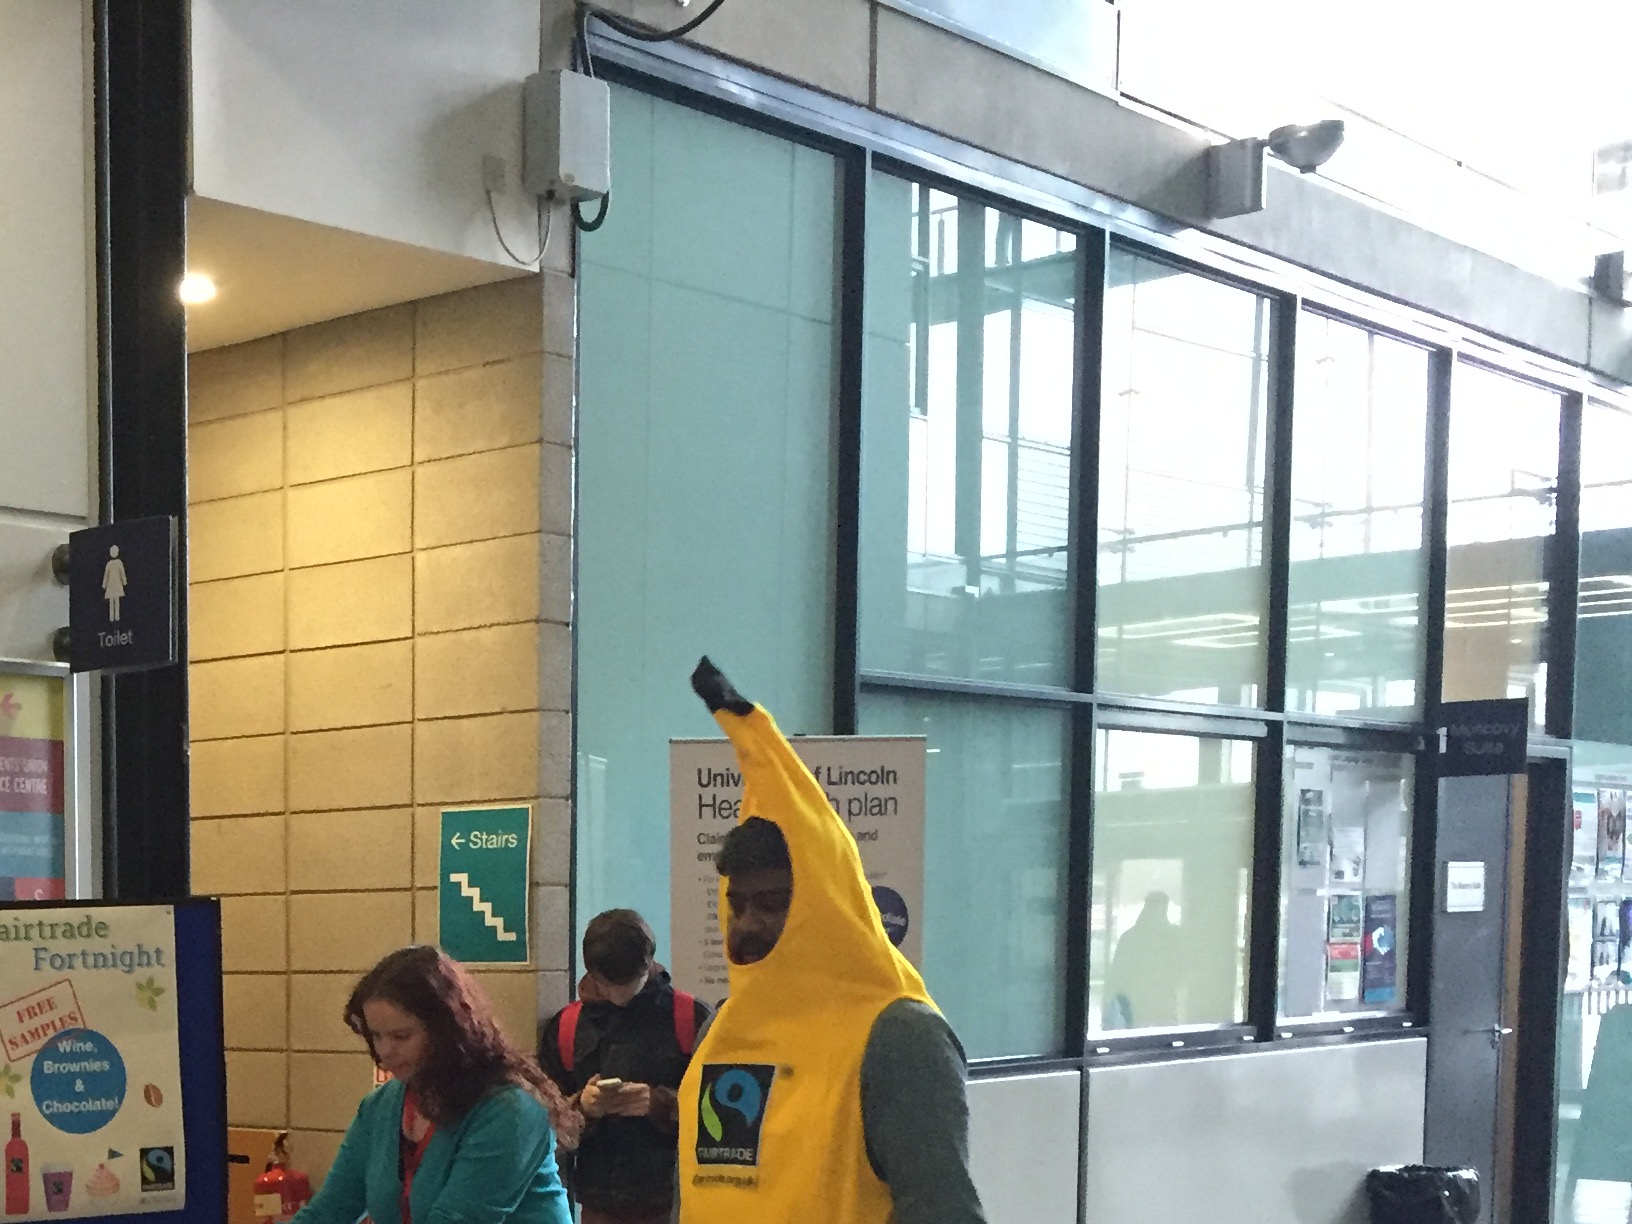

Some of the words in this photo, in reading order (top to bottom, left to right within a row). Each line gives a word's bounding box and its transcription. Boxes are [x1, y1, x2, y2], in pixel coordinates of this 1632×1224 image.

[97, 630, 134, 648] Toilet
[827, 765, 898, 787] Lincoln
[13, 778, 48, 794] CENTRE
[848, 792, 899, 822] plan
[469, 829, 518, 849] Stairs
[856, 829, 879, 842] and
[33, 943, 166, 974] Fortnight
[16, 996, 59, 1025] FREE
[8, 1011, 79, 1051] SAMPLES
[57, 1040, 98, 1054] Wine,
[43, 1059, 110, 1075] Brownies
[74, 1078, 86, 1093] &
[42, 1096, 119, 1115] Chocolate!
[698, 1147, 754, 1161] FAIRTRADE
